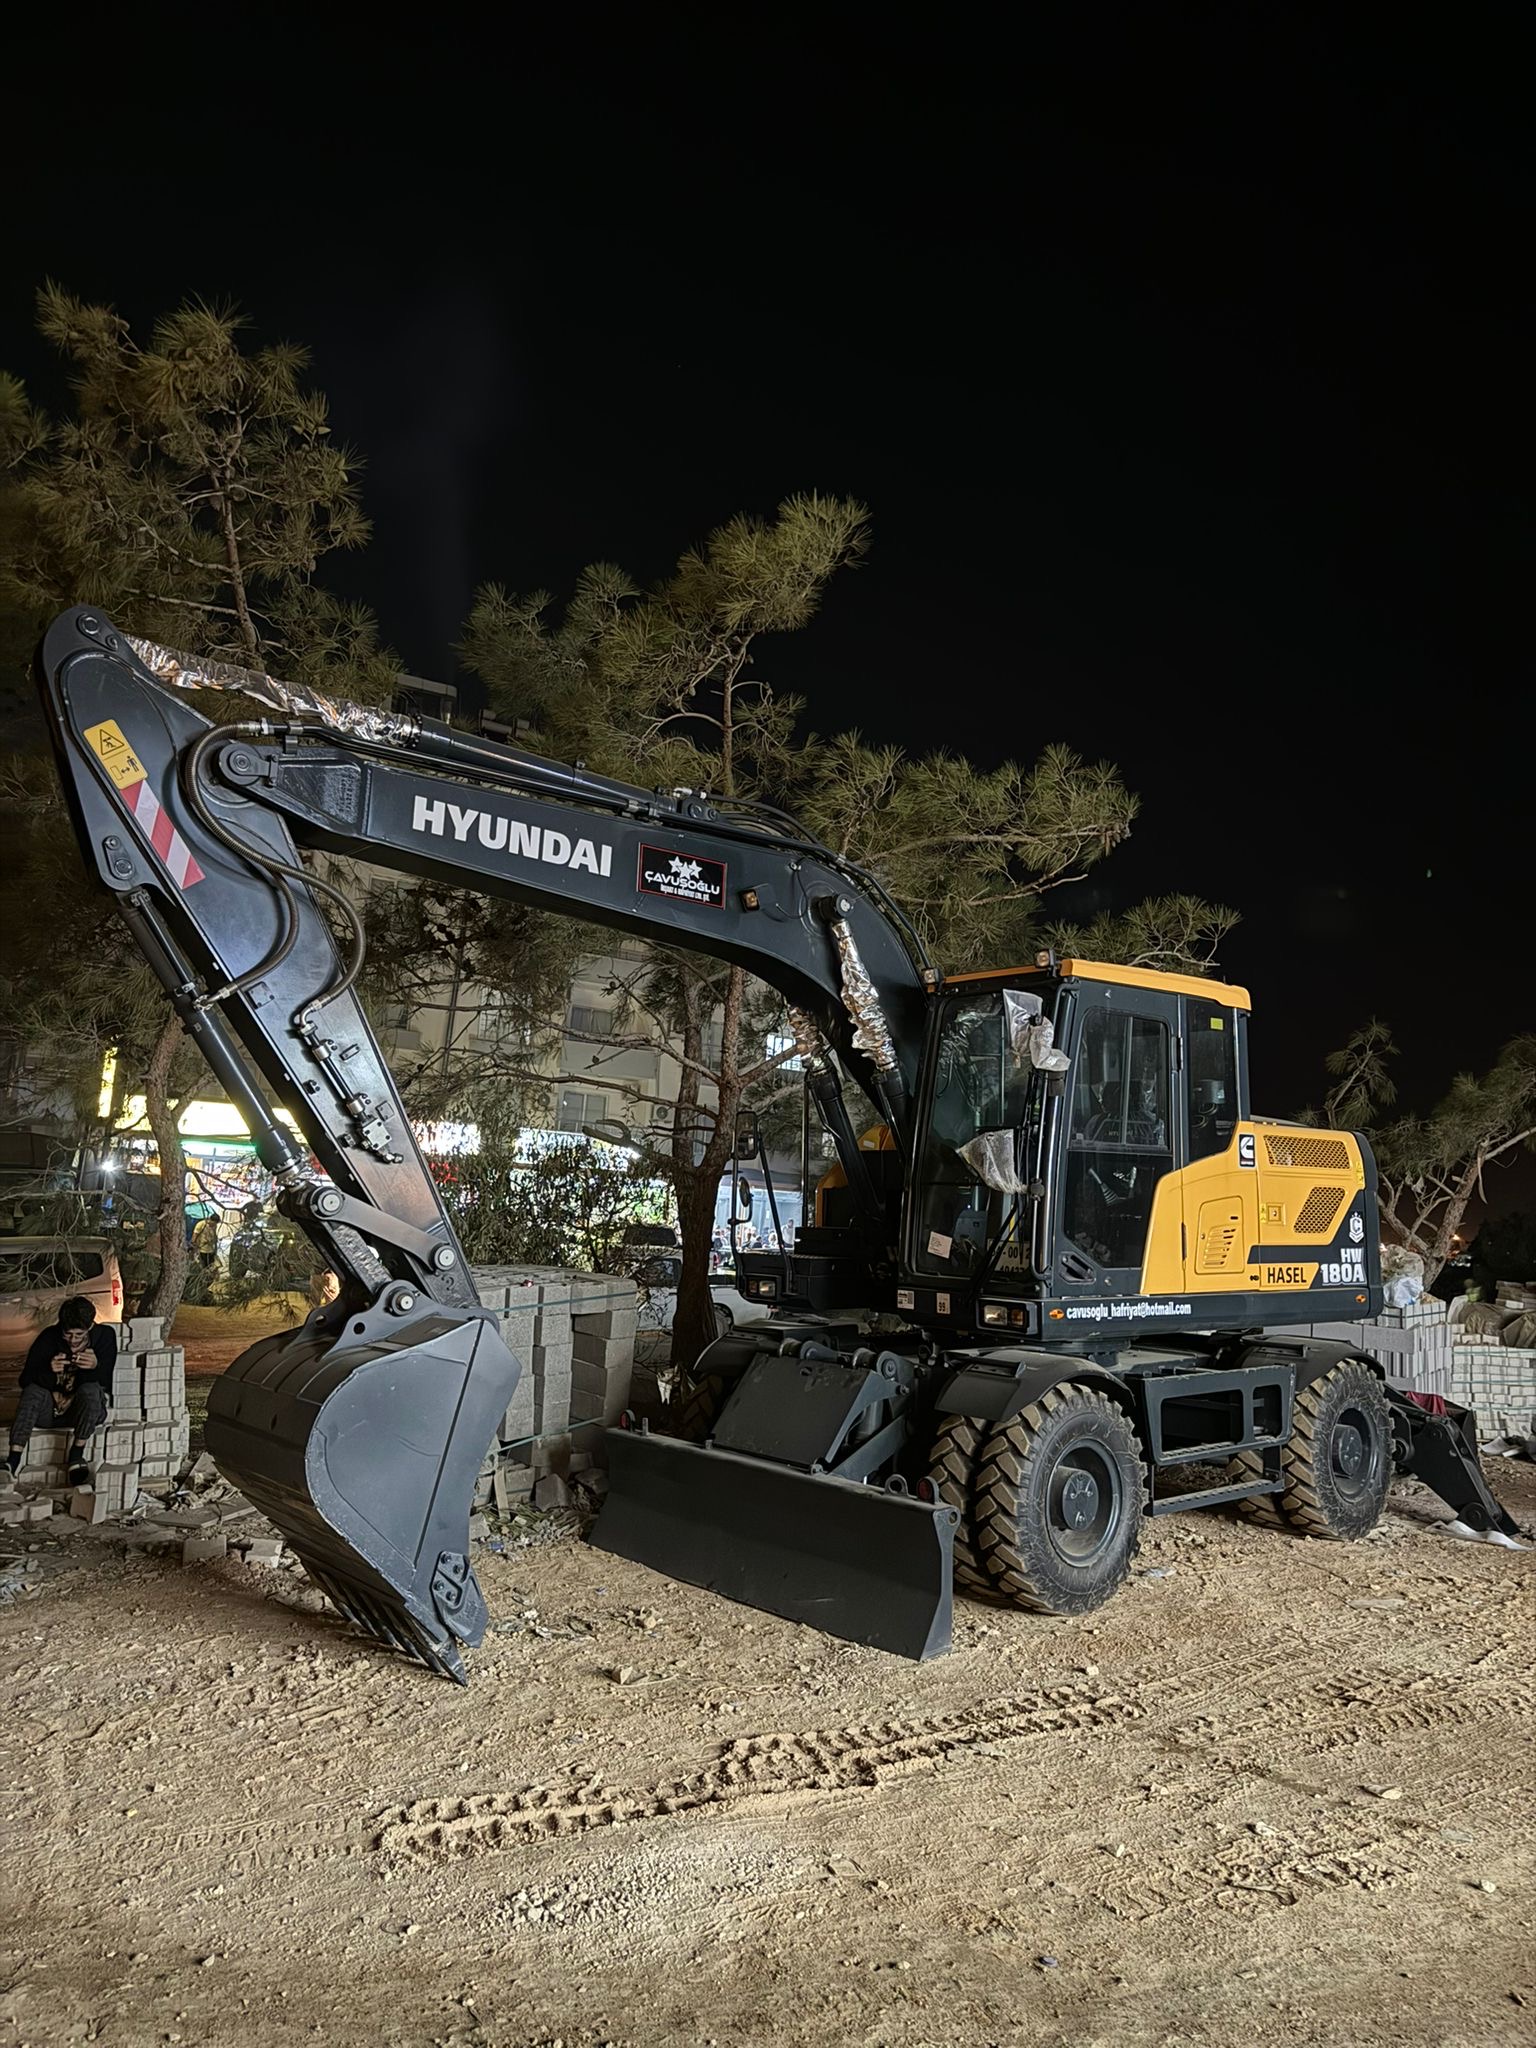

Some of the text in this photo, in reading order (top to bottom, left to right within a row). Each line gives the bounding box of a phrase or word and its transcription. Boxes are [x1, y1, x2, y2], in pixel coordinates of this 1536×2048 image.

[412, 795, 613, 878] HYUNDAI
[644, 870, 720, 895] ÇAVUŞOĞLU
[1340, 1248, 1362, 1263] HW
[1267, 1266, 1307, 1284] HASEL
[1320, 1263, 1366, 1284] 180A
[1066, 1301, 1192, 1321] cavusoglu_hafriyat@hotmail.com
